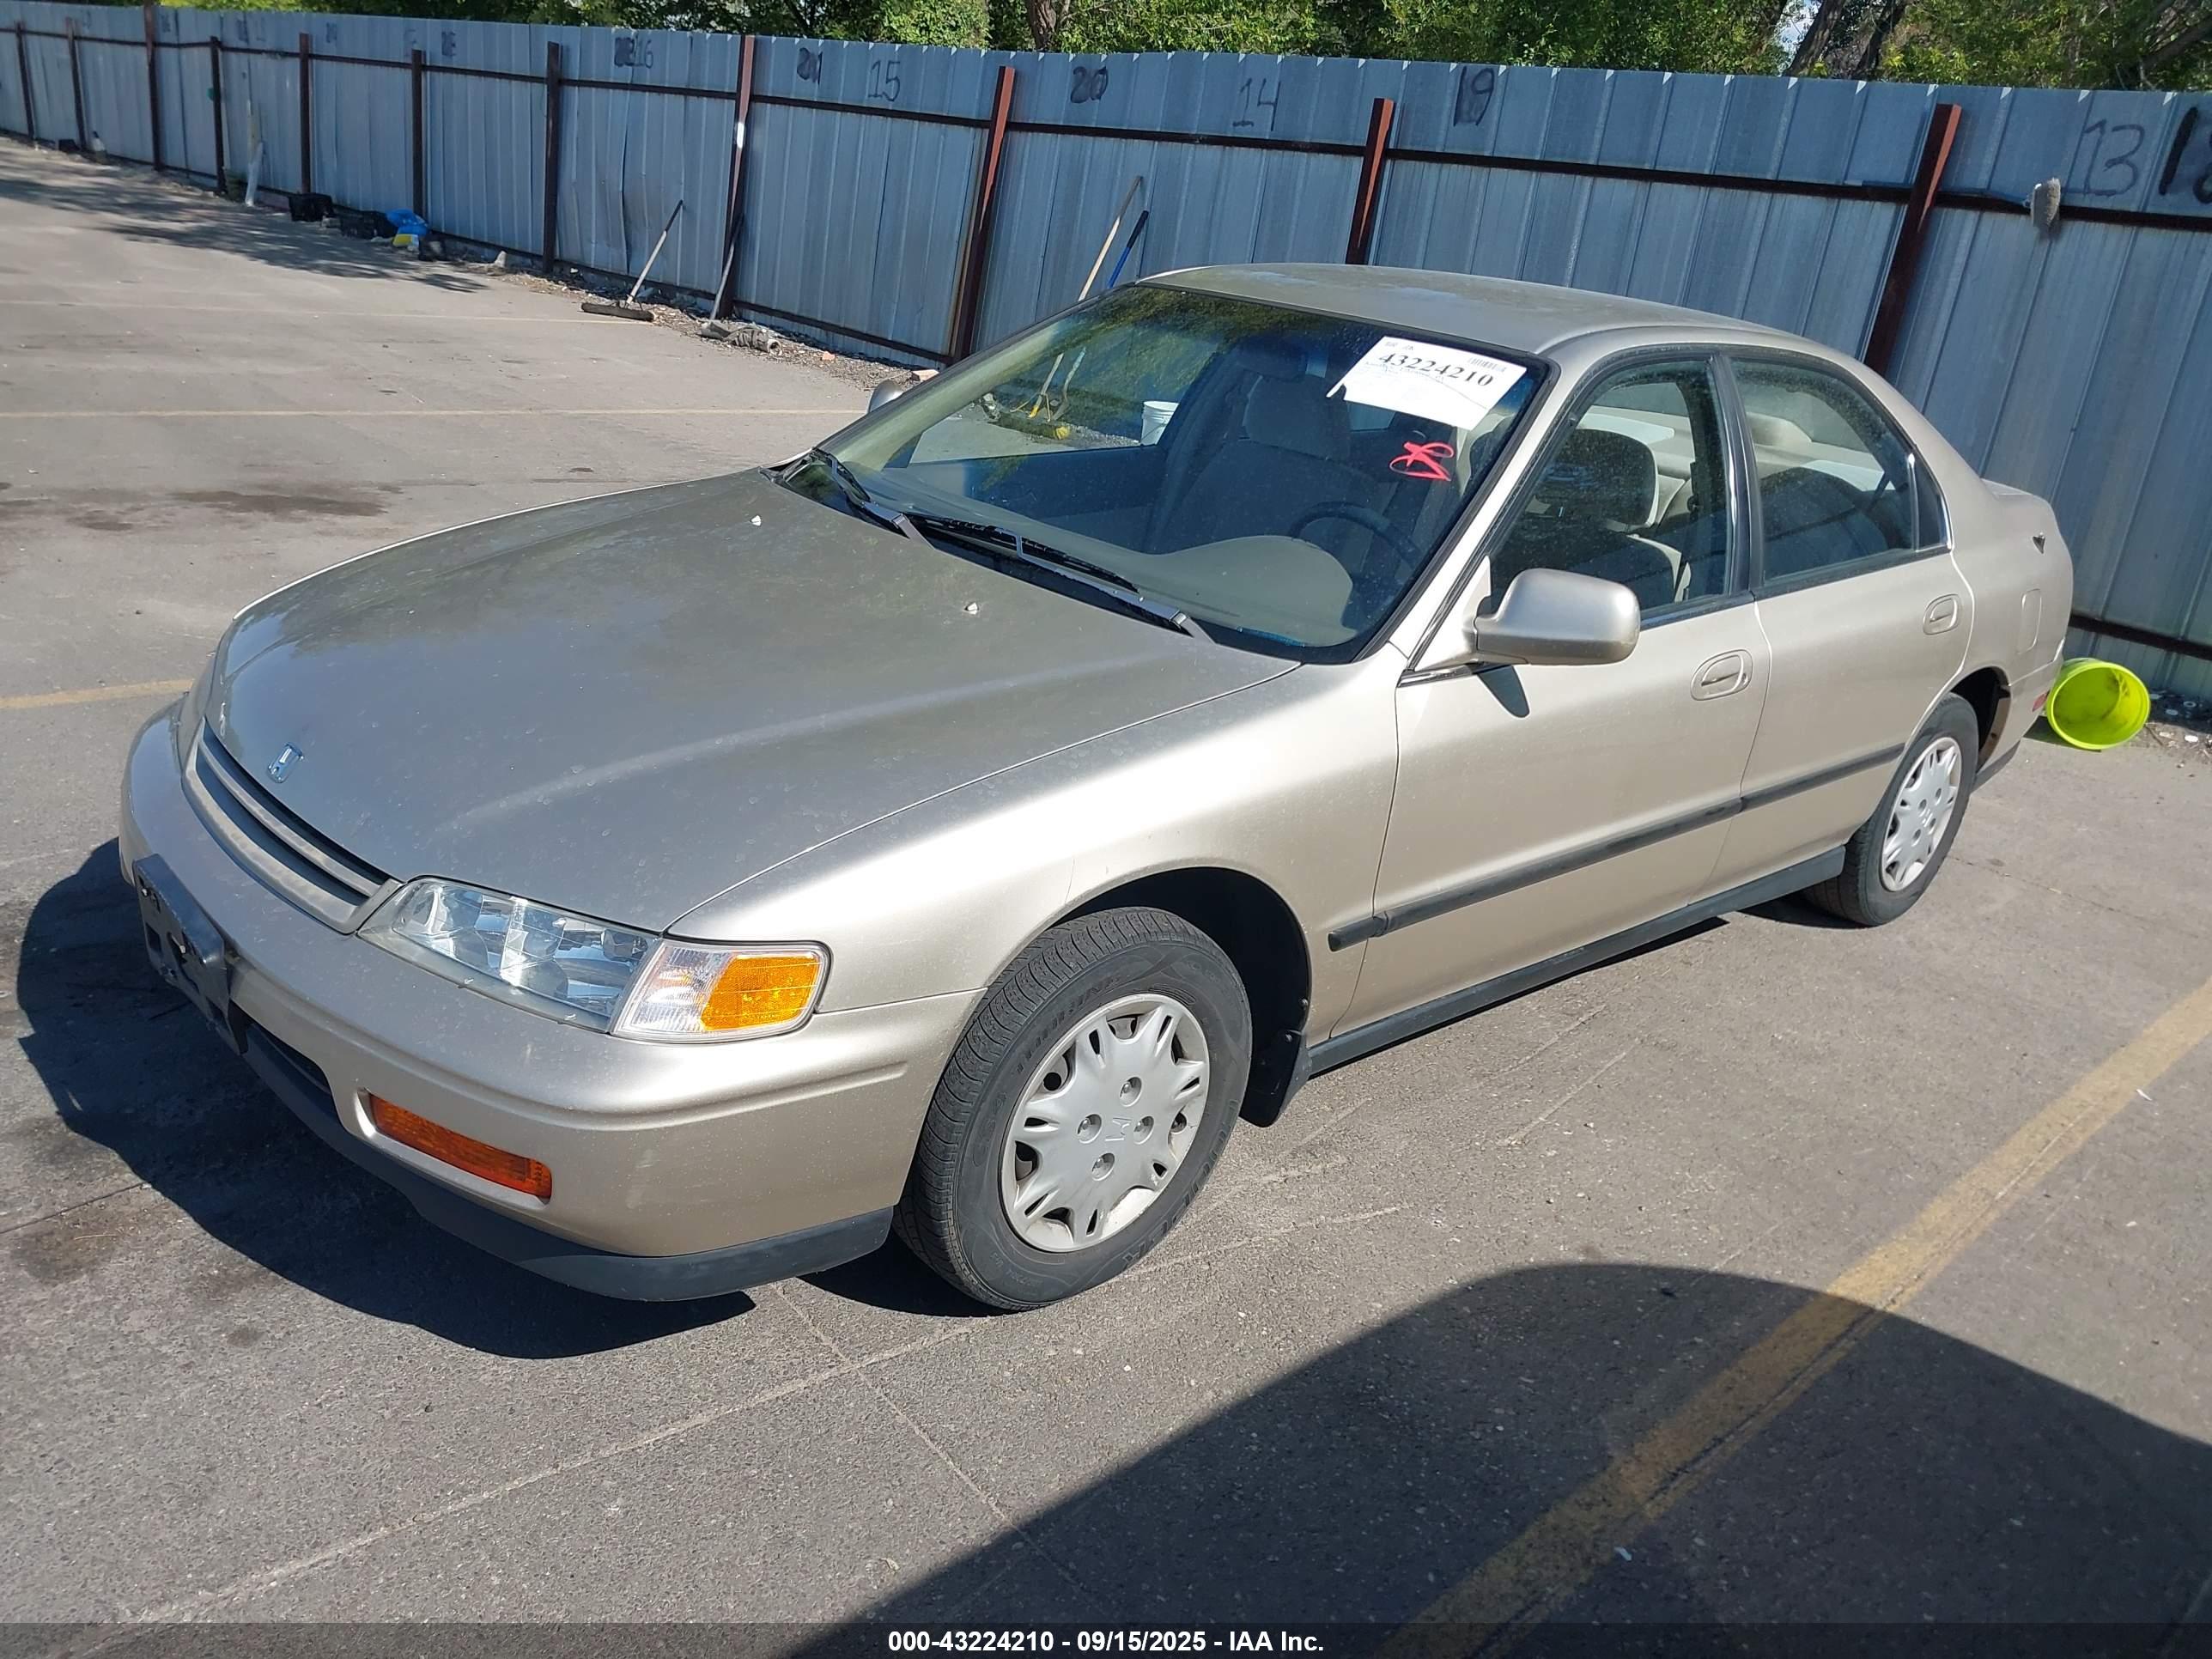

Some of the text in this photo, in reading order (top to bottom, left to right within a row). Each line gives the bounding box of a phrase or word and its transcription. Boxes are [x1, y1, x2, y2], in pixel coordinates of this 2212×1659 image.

[867, 59, 901, 102] 15
[1232, 77, 1281, 131] 14
[2063, 118, 2146, 197] 13
[1378, 353, 1495, 386] 43224210
